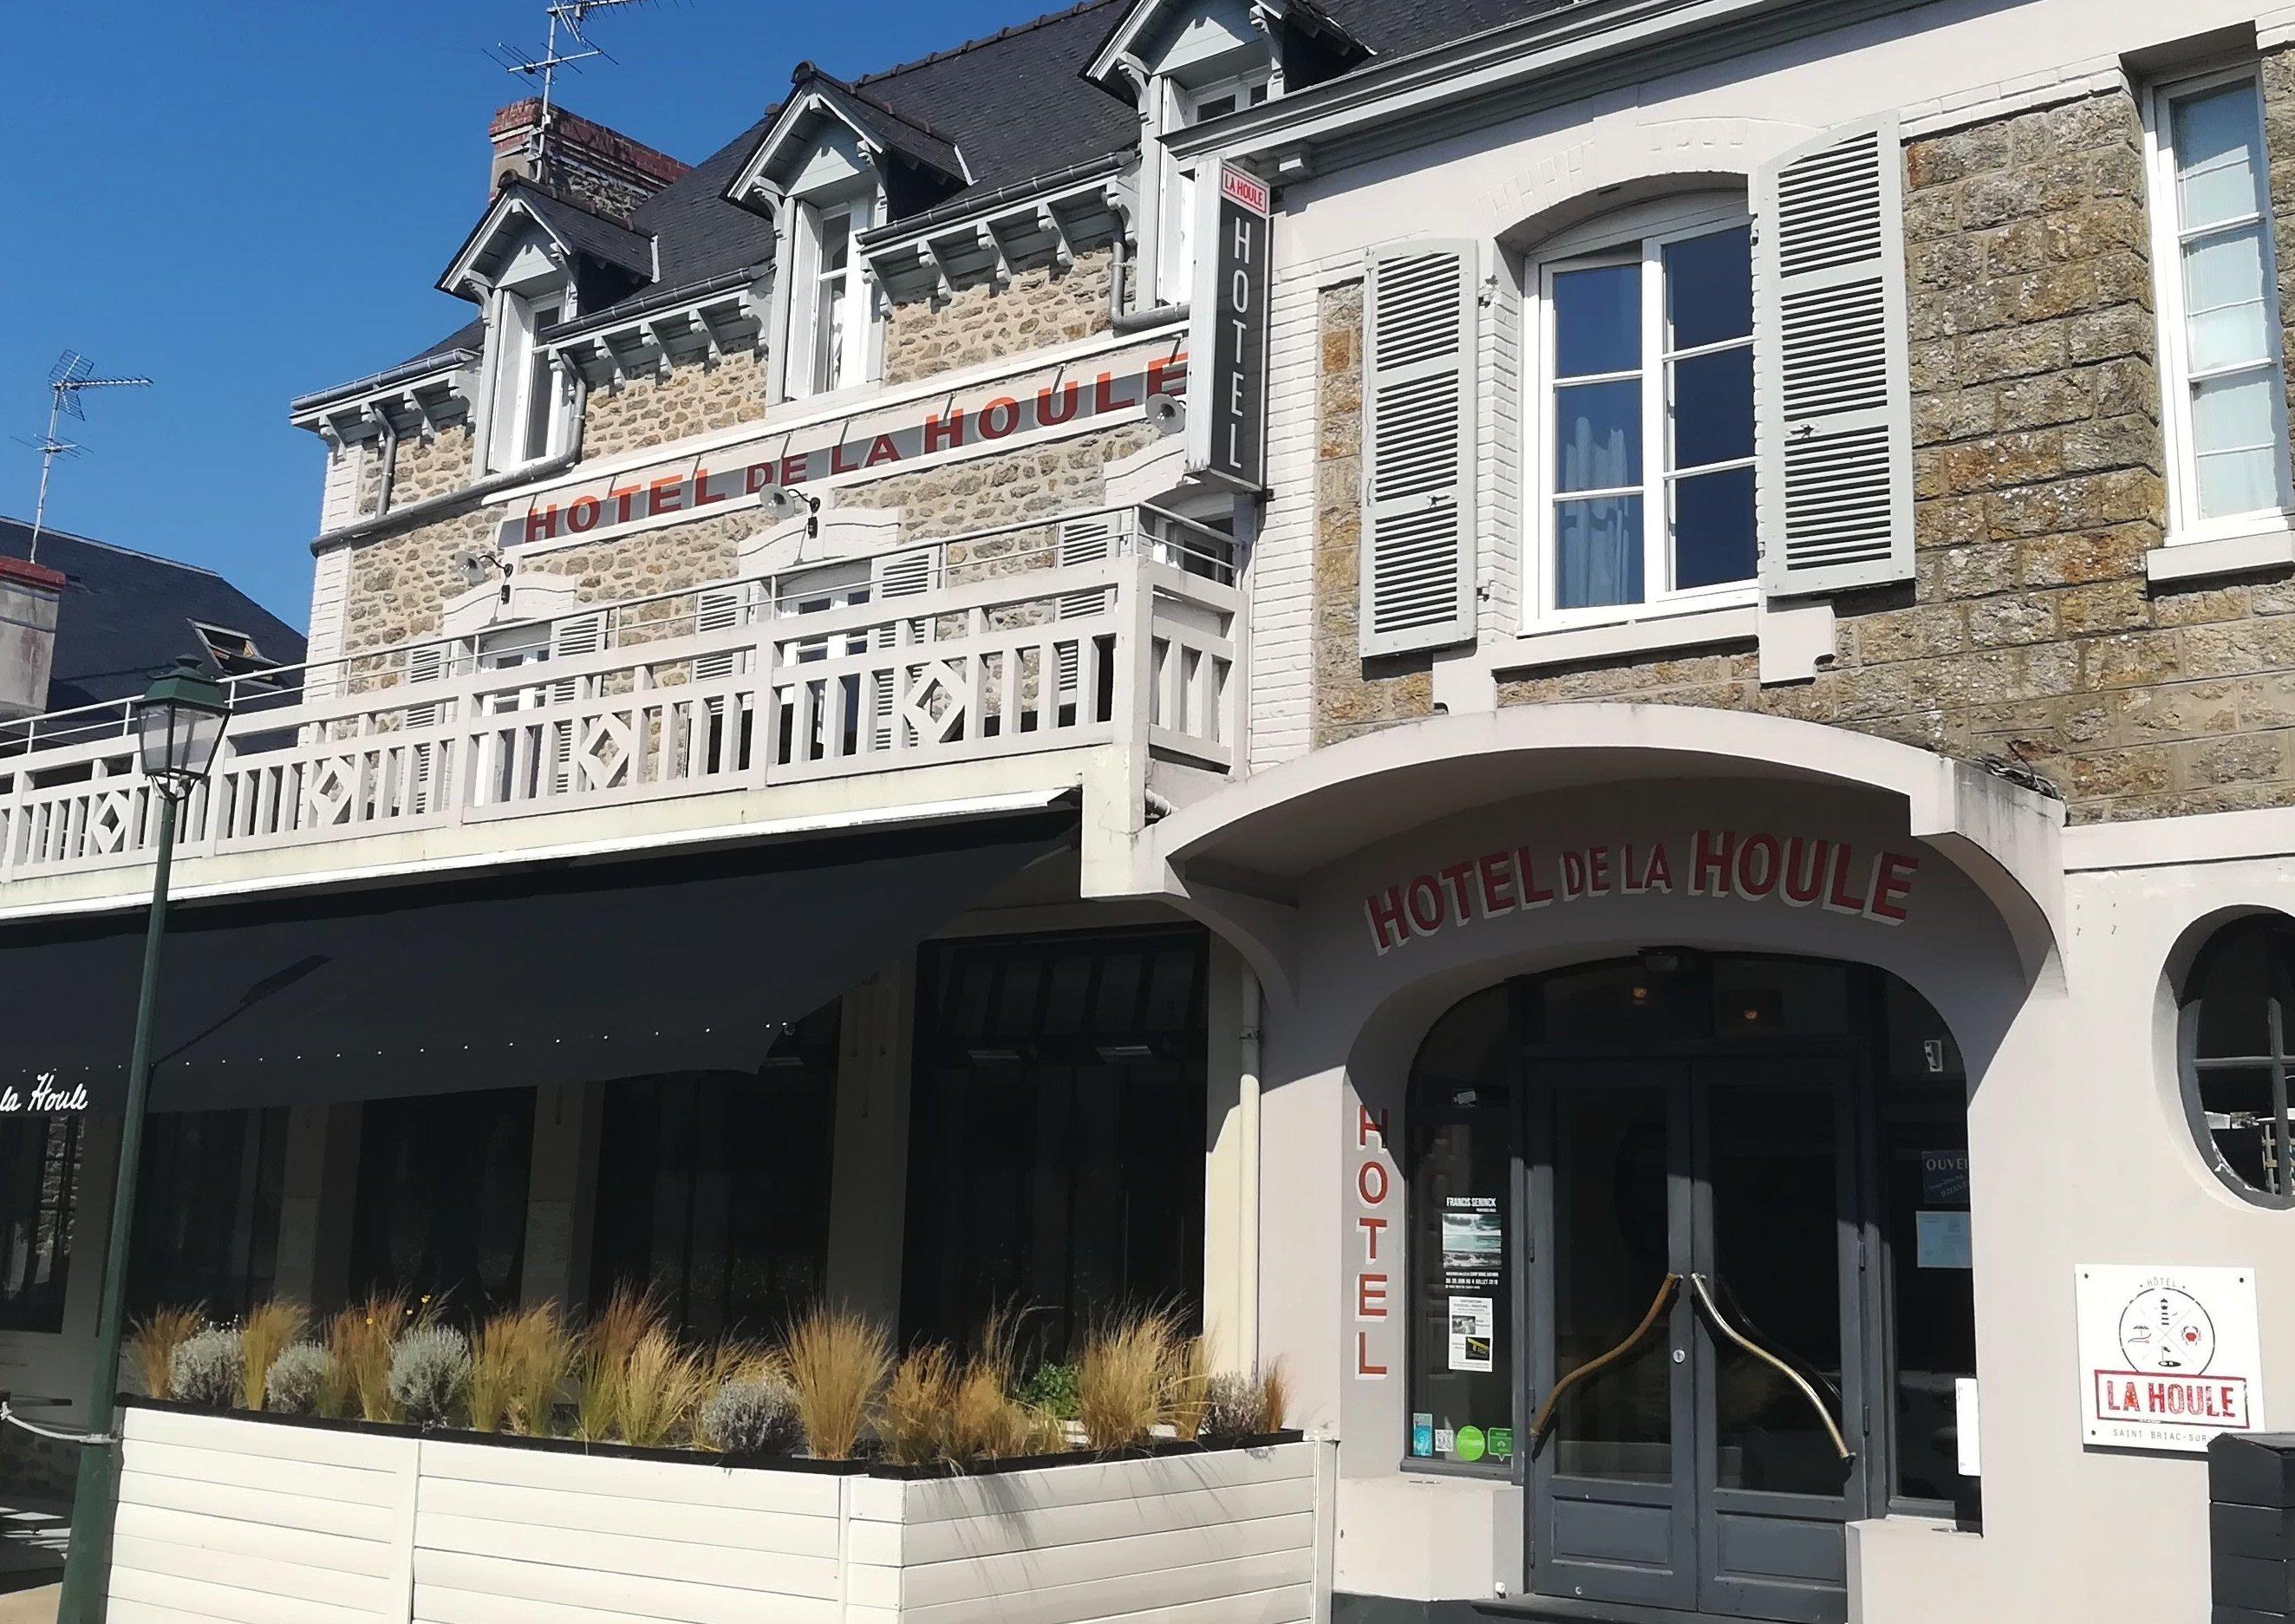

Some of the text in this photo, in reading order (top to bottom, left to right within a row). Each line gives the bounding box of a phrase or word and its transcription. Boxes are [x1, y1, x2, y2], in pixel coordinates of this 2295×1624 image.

[1225, 173, 1263, 207] LA HOULE
[1229, 216, 1251, 469] HOTEL
[523, 351, 1189, 544] HOTEL DE LA HOULE
[1364, 829, 1920, 956] HOTEL DE LA HOULE
[27, 1072, 88, 1112] Houle
[1354, 1103, 1388, 1380] HOTEL
[2107, 1380, 2236, 1418] LA HOULE
[2113, 1428, 2143, 1438] SAINT
